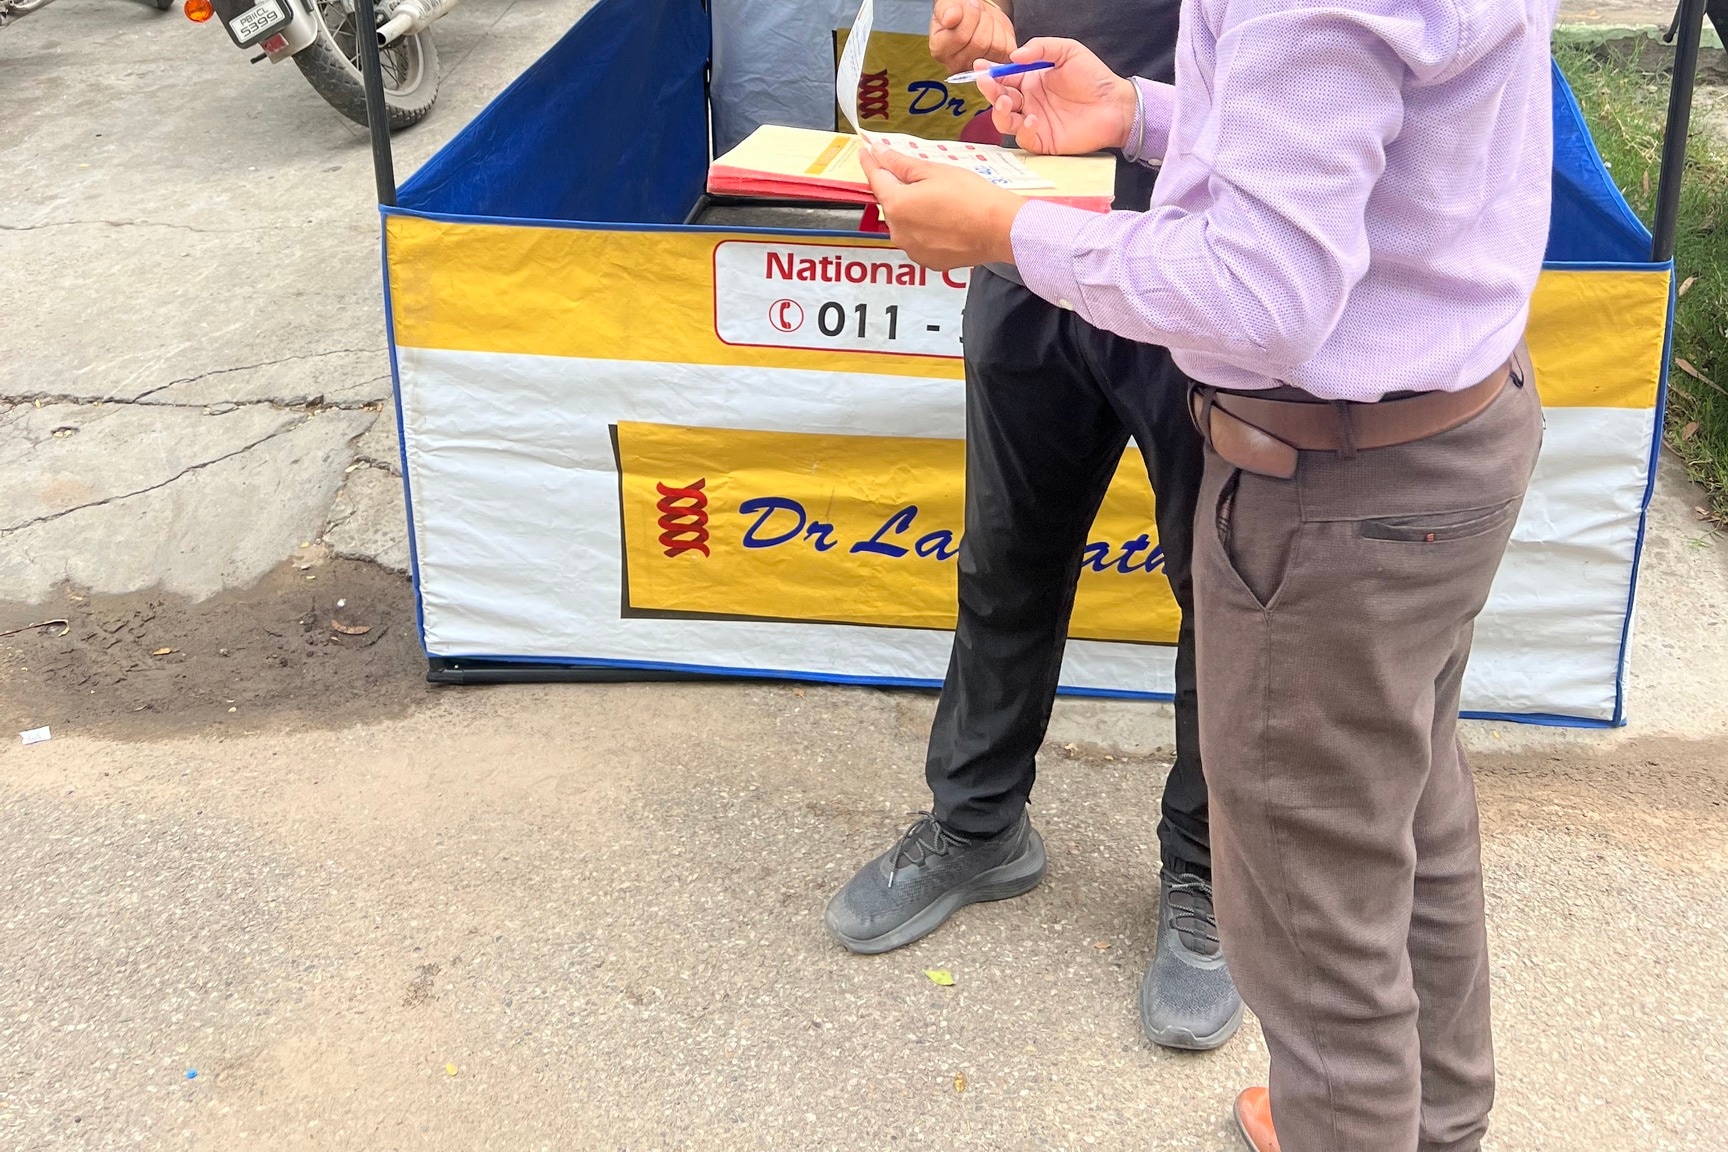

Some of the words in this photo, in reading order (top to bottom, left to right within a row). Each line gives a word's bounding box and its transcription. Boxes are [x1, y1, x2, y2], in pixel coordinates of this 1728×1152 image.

[240, 10, 278, 37] 5399
[907, 80, 967, 116] Dr
[765, 251, 927, 286] National
[818, 301, 899, 339] 011
[738, 496, 837, 552] Dr
